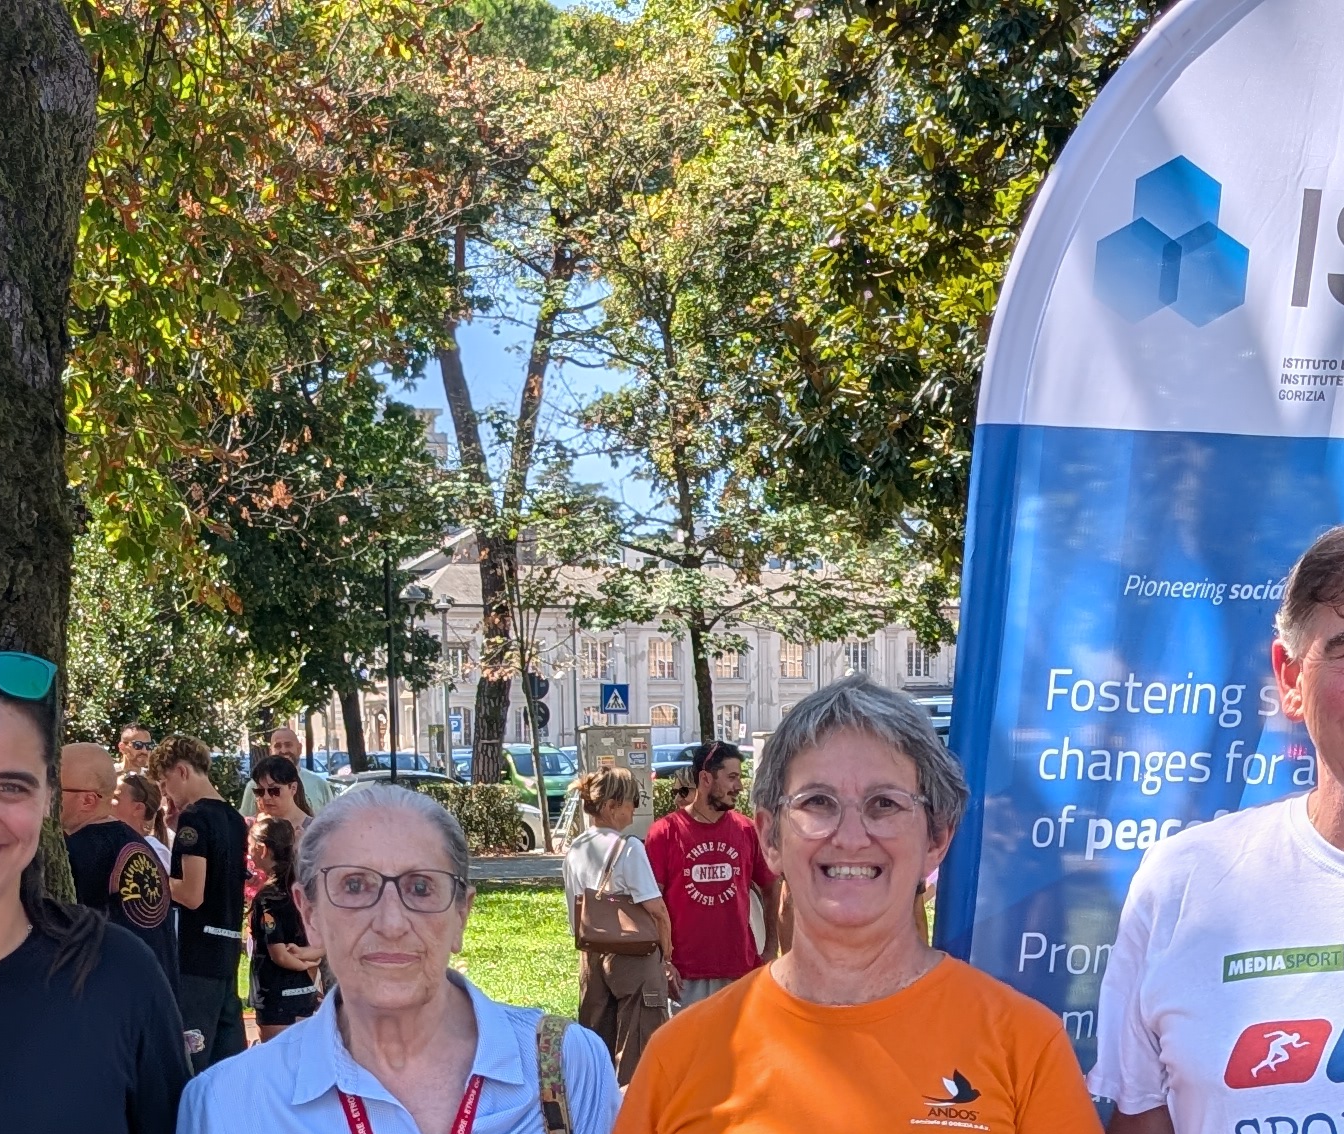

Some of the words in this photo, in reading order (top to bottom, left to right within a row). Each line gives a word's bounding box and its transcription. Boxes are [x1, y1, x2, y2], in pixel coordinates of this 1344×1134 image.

[1282, 357, 1338, 371] ISTITUTO
[1280, 373, 1344, 386] INSTITUTE
[1278, 389, 1326, 402] GORIZIA
[1123, 574, 1228, 606] Pioneering
[1046, 668, 1247, 728] Fostering
[450, 720, 459, 732] P
[1038, 736, 1212, 795] changes
[1225, 740, 1284, 785] for
[1032, 805, 1076, 849] of
[686, 841, 715, 861] THERE
[717, 841, 727, 852] IS
[726, 846, 739, 860] NO
[699, 865, 726, 880] NIKE
[685, 882, 715, 906] FINISH
[1228, 949, 1342, 977] MEDIASPORT
[927, 1106, 977, 1122] ANDOS
